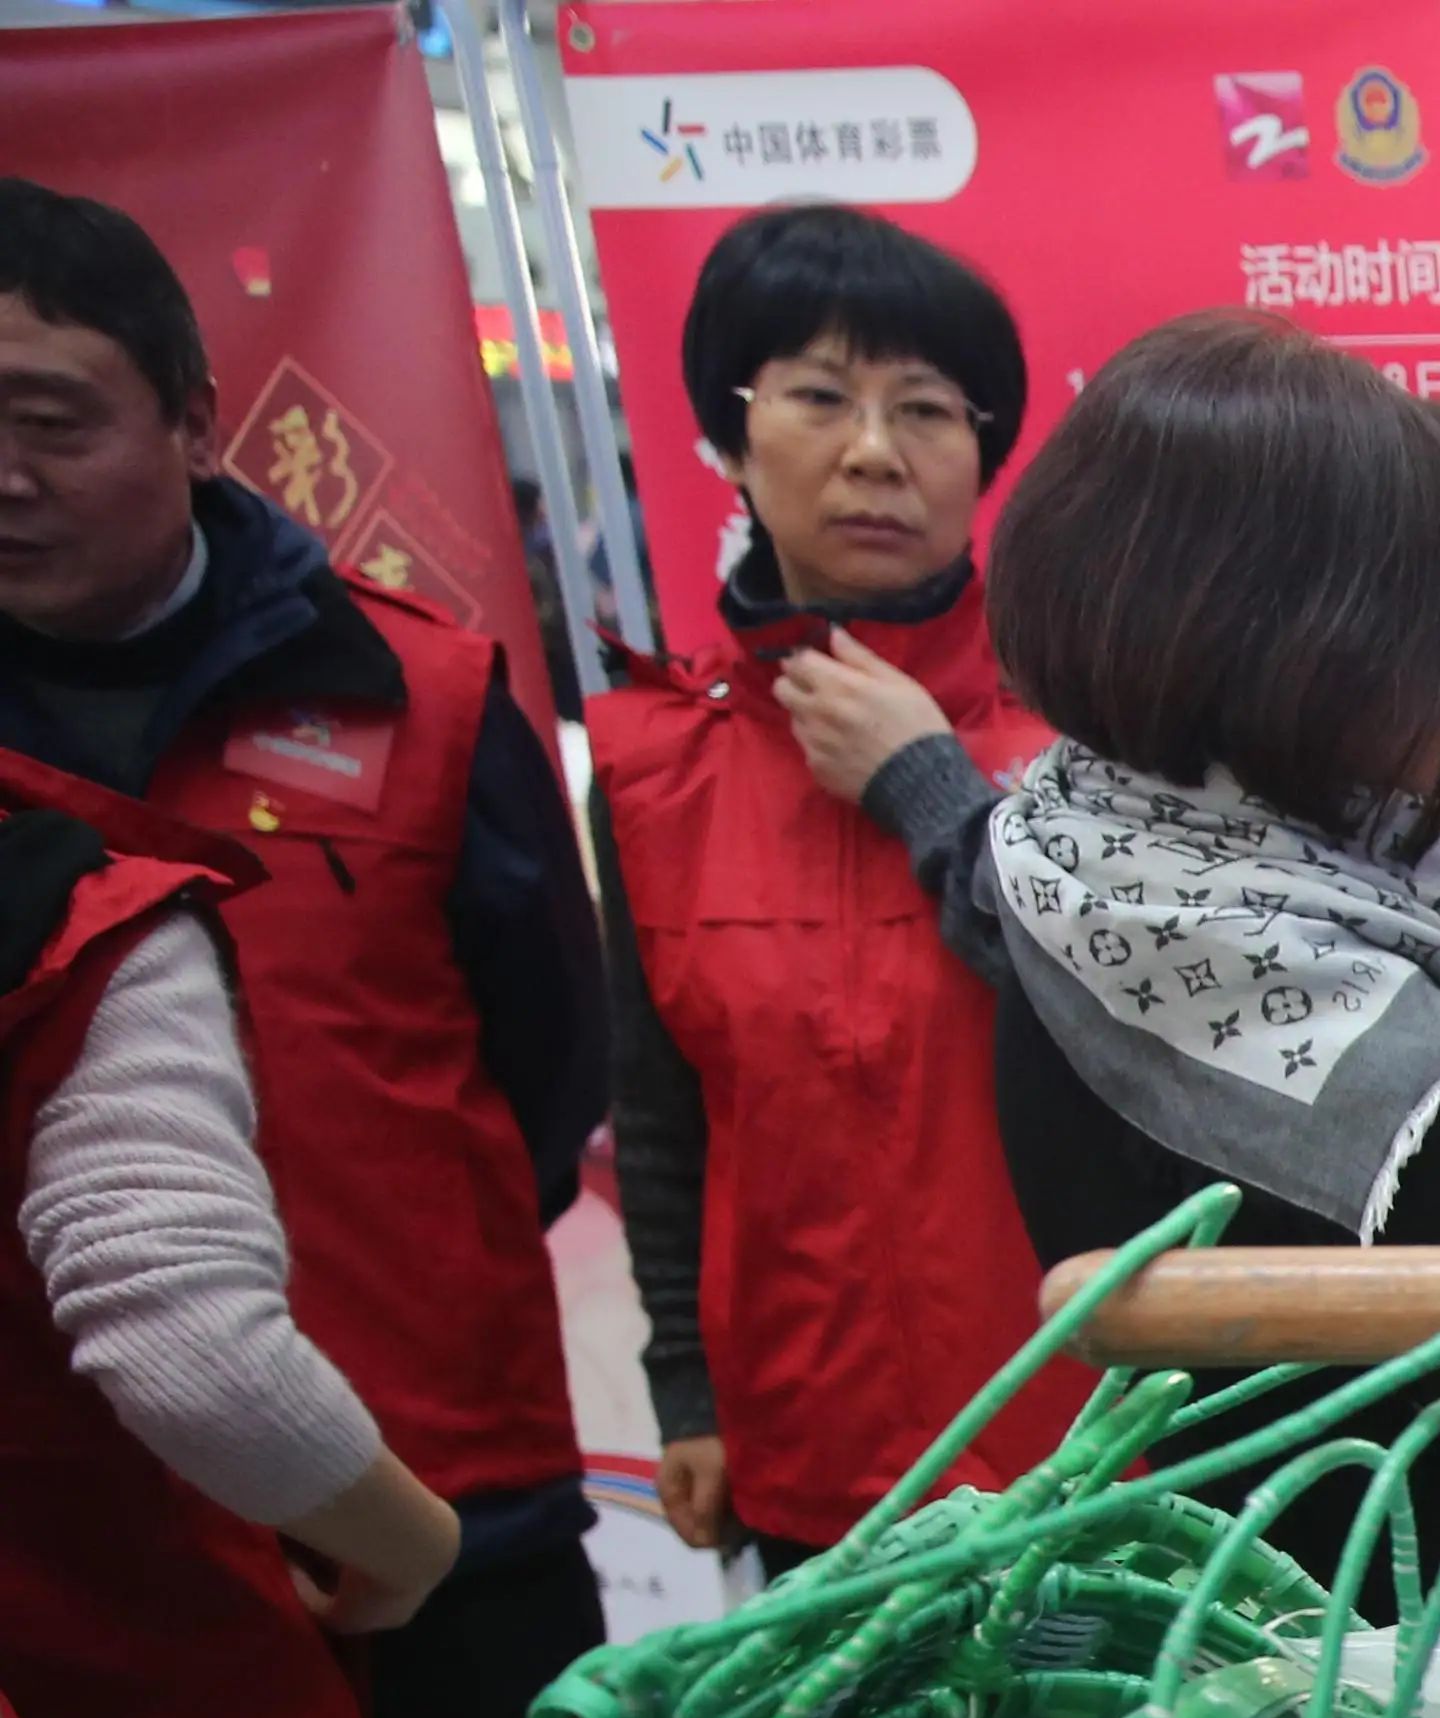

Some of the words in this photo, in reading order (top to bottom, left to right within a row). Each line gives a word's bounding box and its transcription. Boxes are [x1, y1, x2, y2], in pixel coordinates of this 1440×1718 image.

[722, 117, 943, 168] 中国体育彩票
